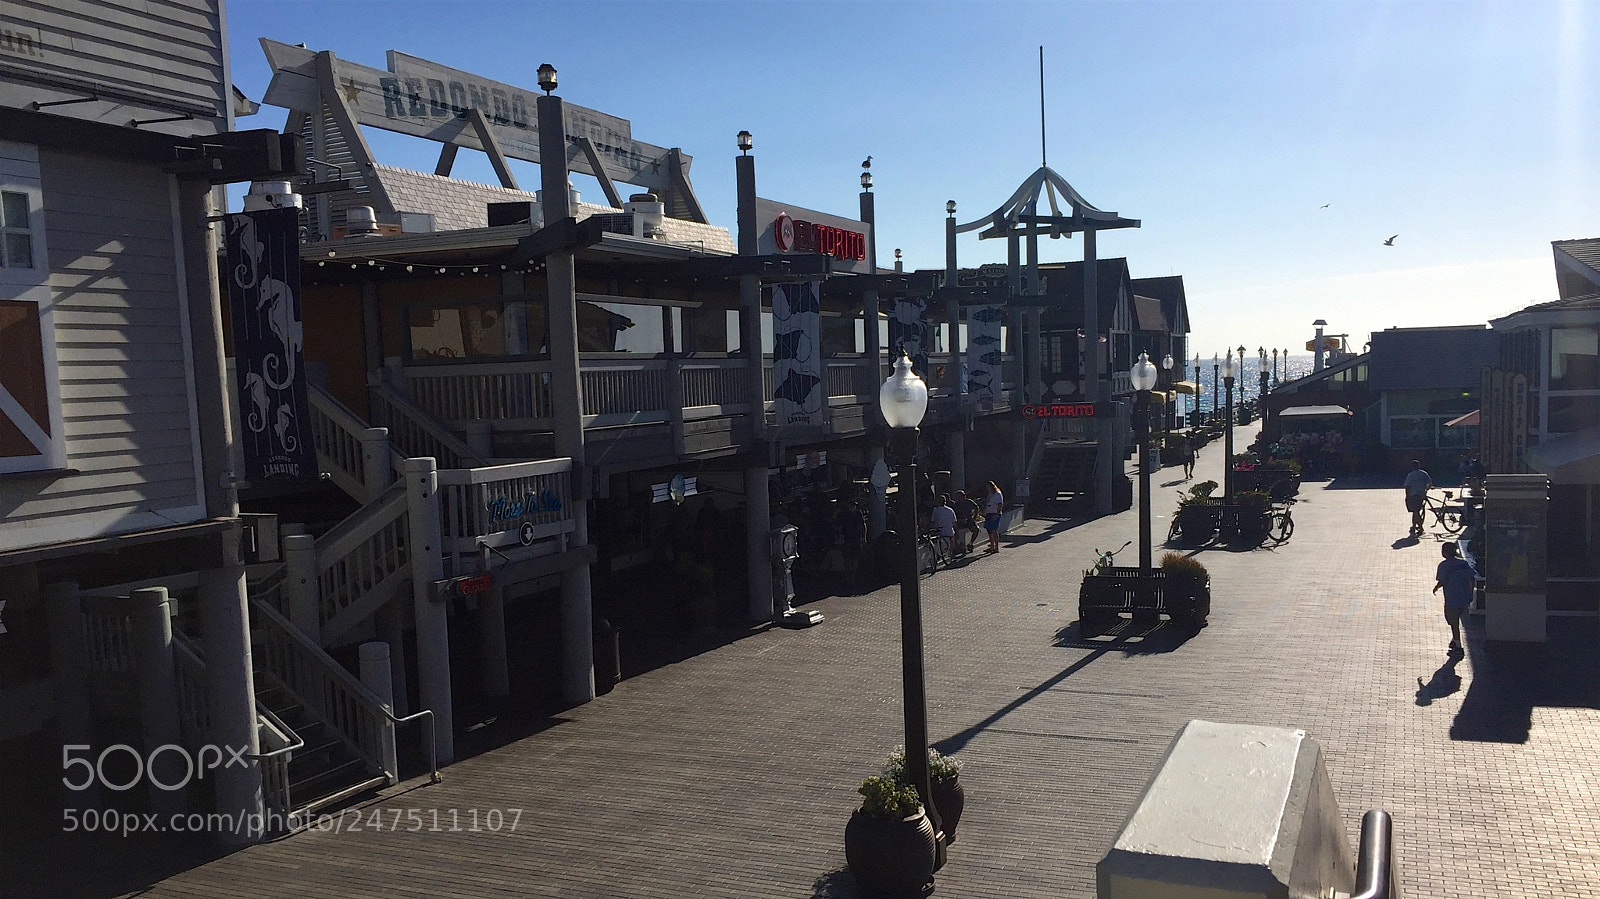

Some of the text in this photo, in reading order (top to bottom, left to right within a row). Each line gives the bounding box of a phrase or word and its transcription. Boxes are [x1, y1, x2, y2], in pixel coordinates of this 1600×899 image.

[379, 77, 528, 130] REDONDO
[816, 224, 866, 261] TORITO
[1037, 404, 1094, 417] EL TORITO
[263, 463, 300, 478] LANDING
[489, 496, 524, 523] More
